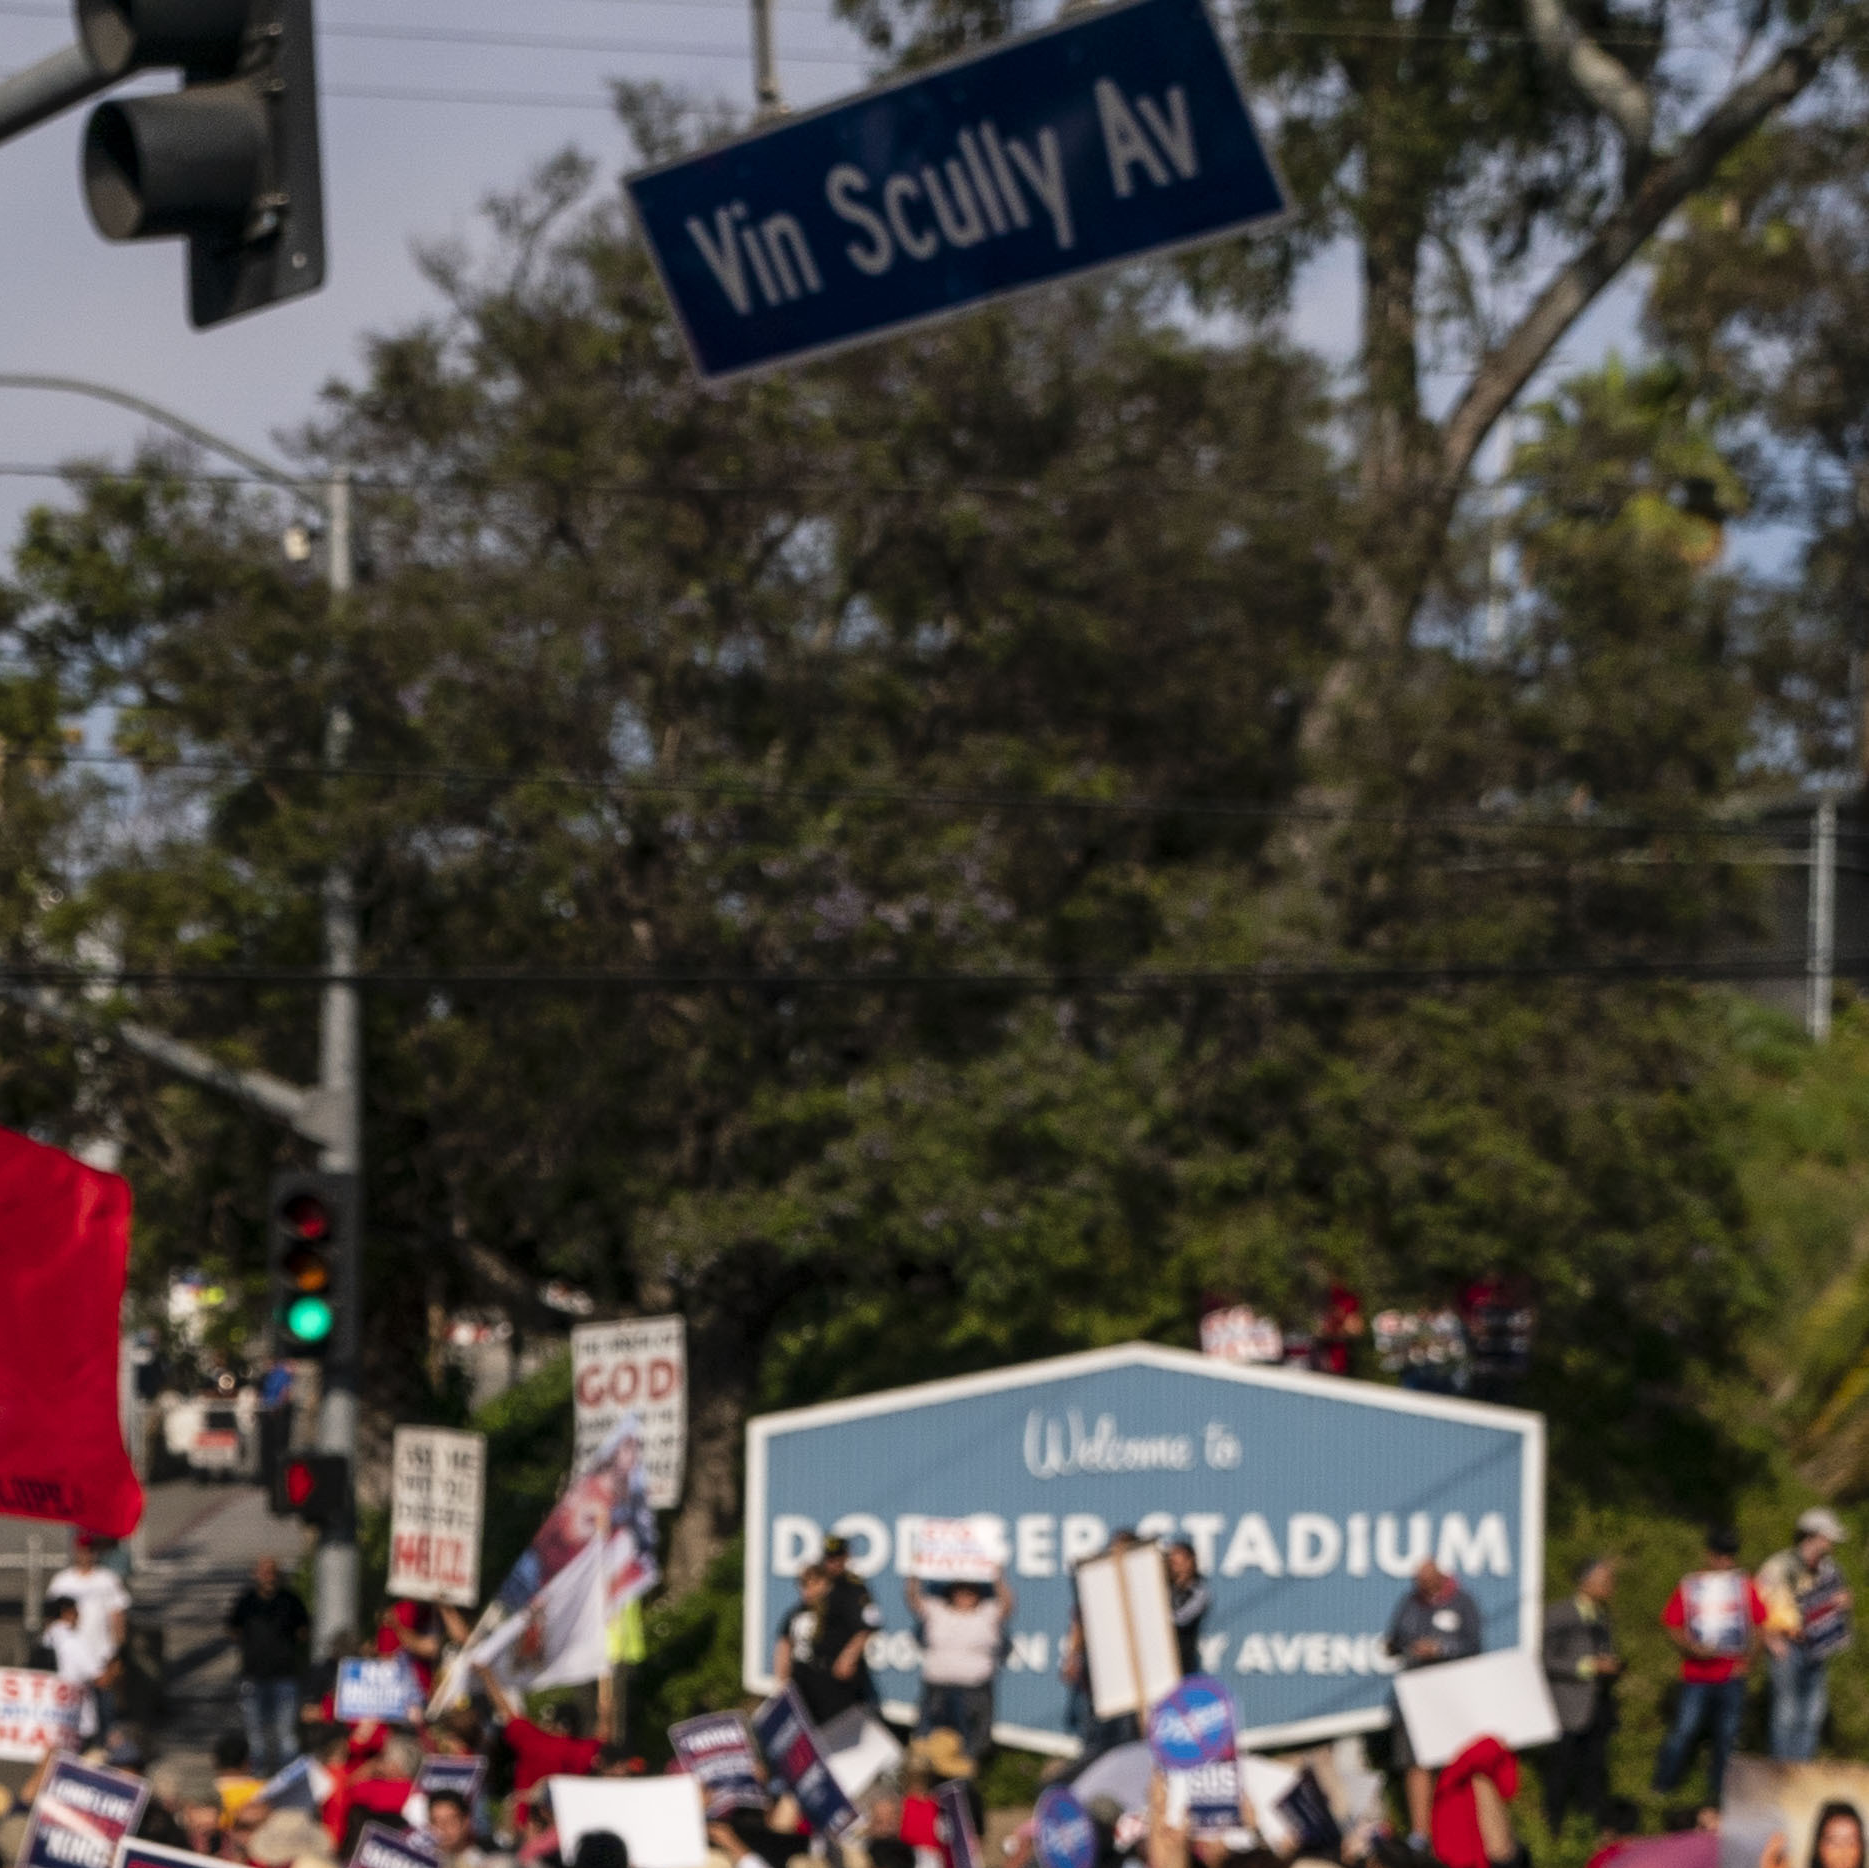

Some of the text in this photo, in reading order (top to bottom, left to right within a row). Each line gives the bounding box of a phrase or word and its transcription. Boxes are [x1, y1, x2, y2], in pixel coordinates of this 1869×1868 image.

[686, 78, 1200, 315] Vin Scully Av
[576, 1360, 674, 1409] GOD
[1023, 1408, 1242, 1478] Welcome to
